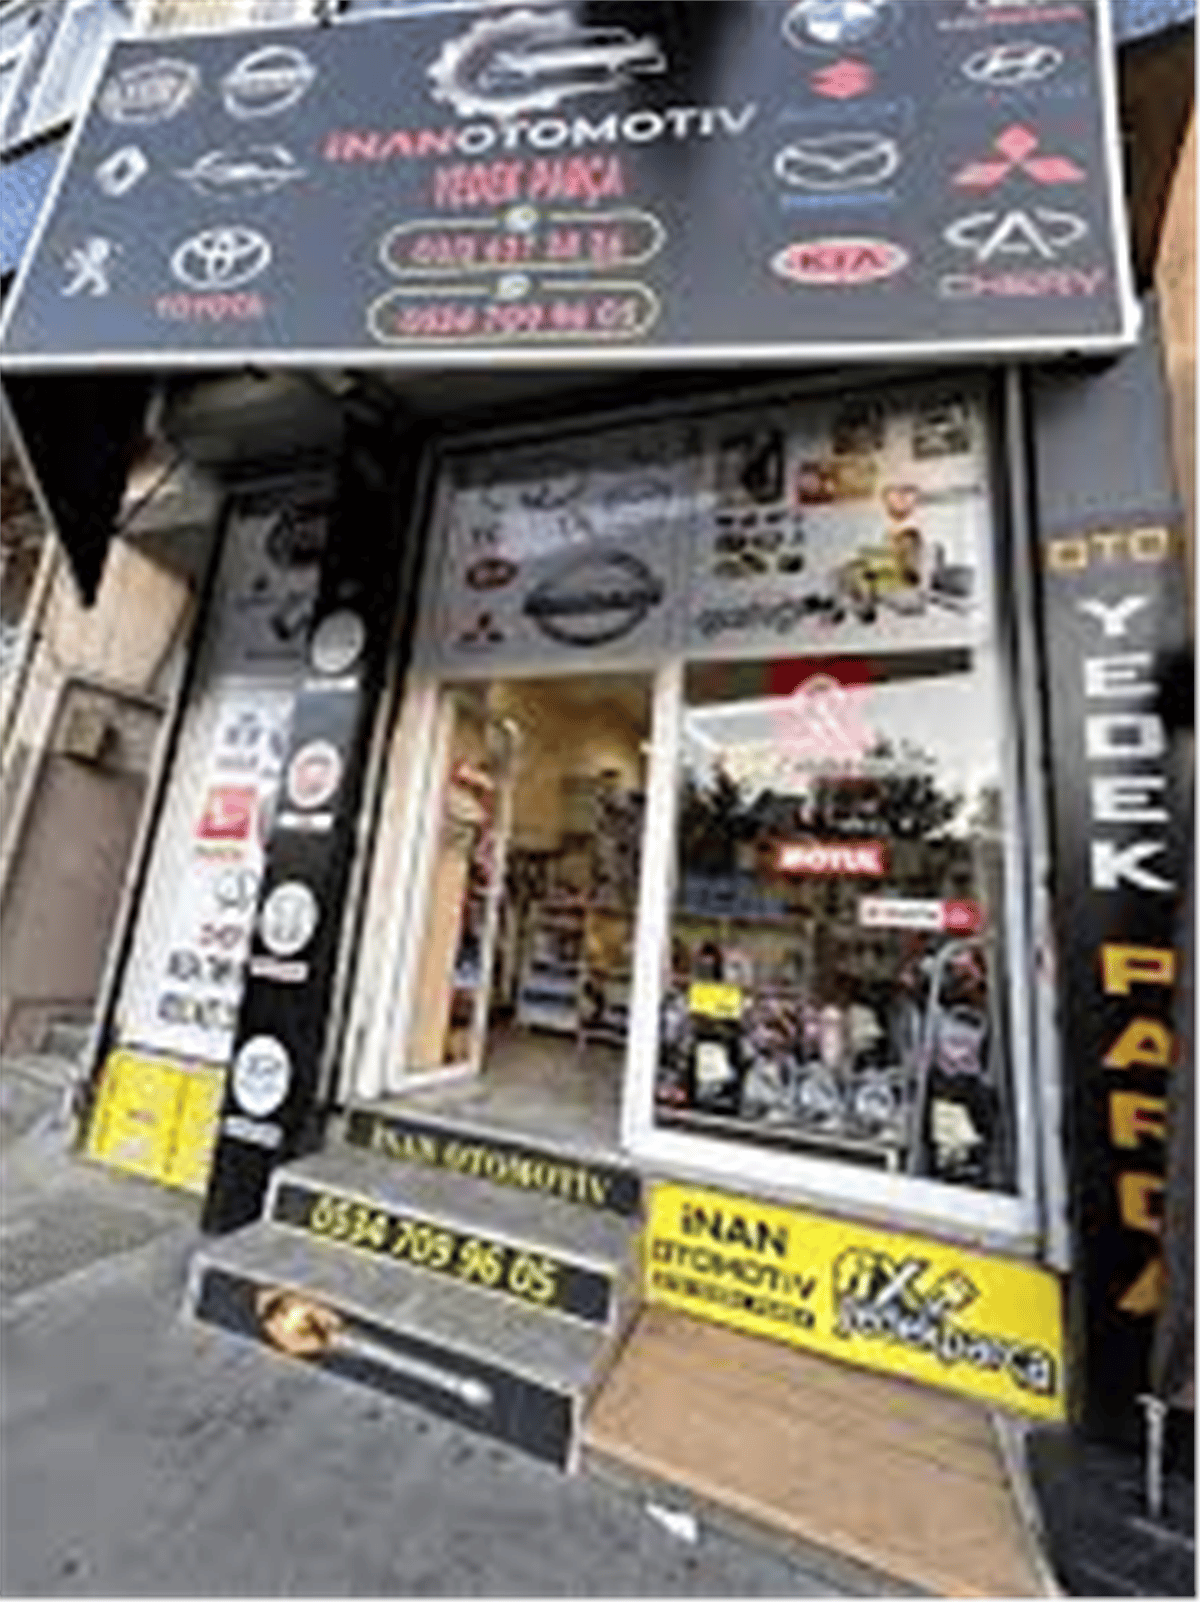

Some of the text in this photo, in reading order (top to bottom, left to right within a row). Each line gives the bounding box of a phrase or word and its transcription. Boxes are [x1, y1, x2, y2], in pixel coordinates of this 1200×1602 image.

[1046, 525, 1170, 572] OTO
[1078, 594, 1176, 892] YEDEK
[507, 1256, 558, 1300] 05
